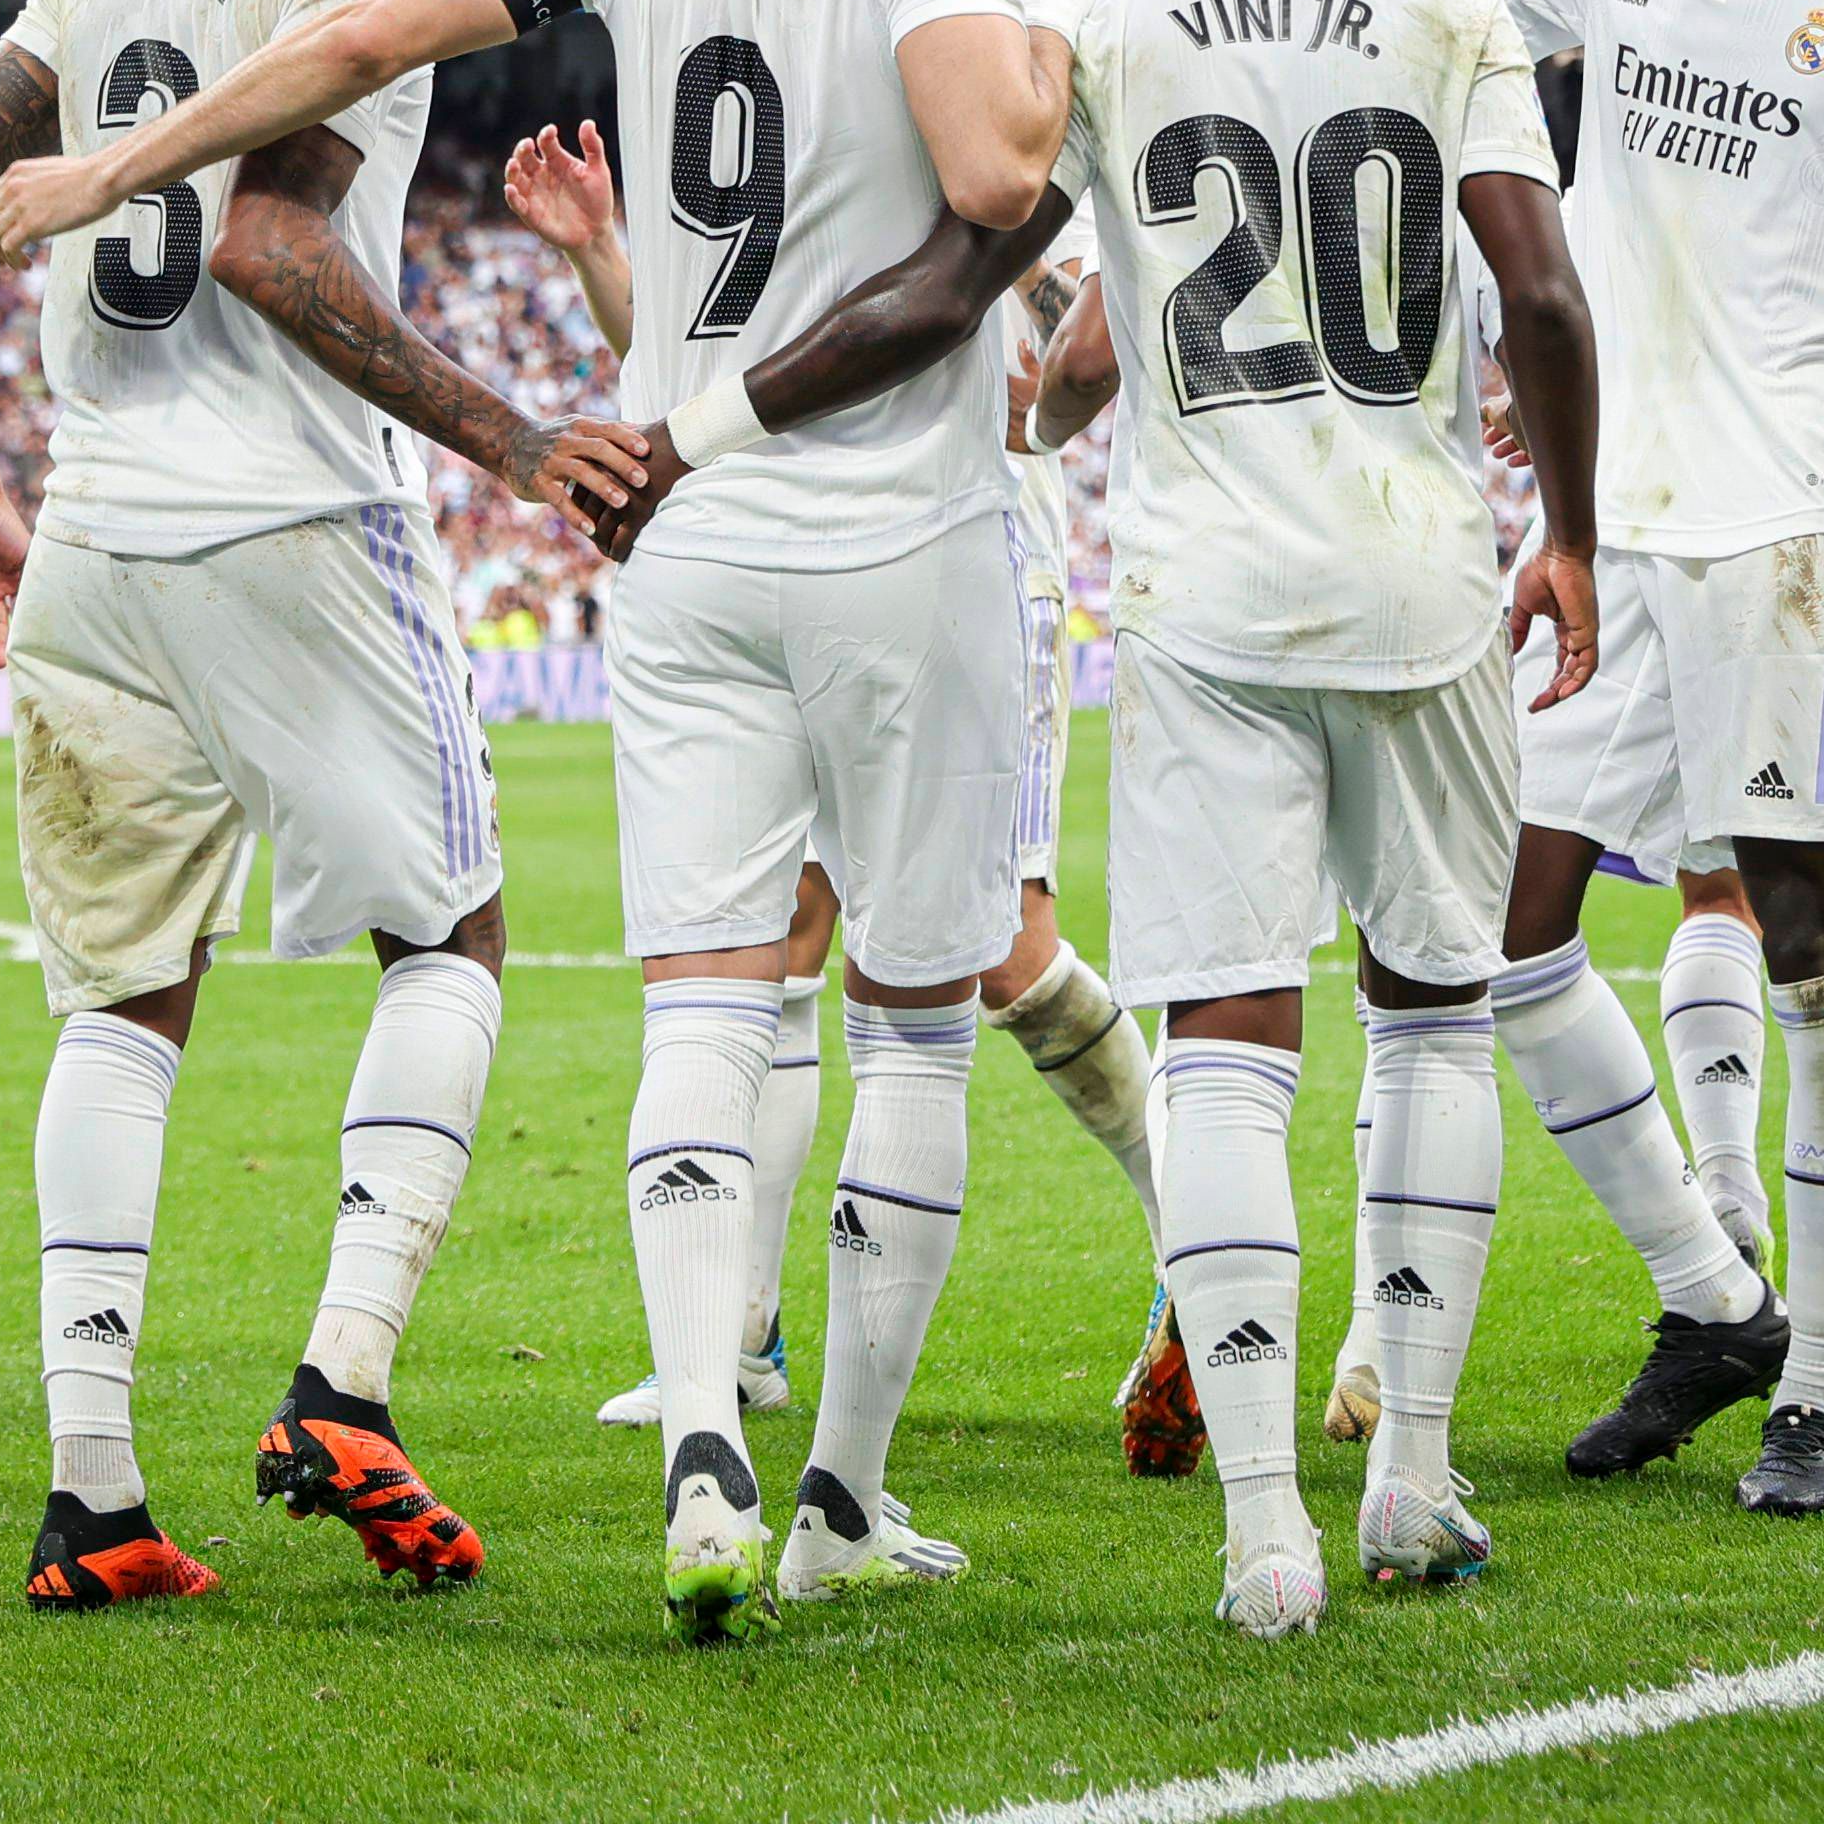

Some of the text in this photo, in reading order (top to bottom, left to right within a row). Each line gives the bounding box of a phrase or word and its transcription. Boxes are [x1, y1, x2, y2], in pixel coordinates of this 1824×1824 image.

[1614, 43, 1803, 137] Emirates
[1622, 109, 1758, 180] FLY BETTER
[670, 35, 785, 342] 9
[1133, 107, 1444, 418] 20
[1744, 784, 1794, 800] adidas
[1695, 1072, 1755, 1090] adidas
[640, 1183, 737, 1212] adidas
[1374, 1288, 1444, 1311] adidas
[64, 1326, 135, 1351] adidas
[1206, 1344, 1288, 1368] adidas
